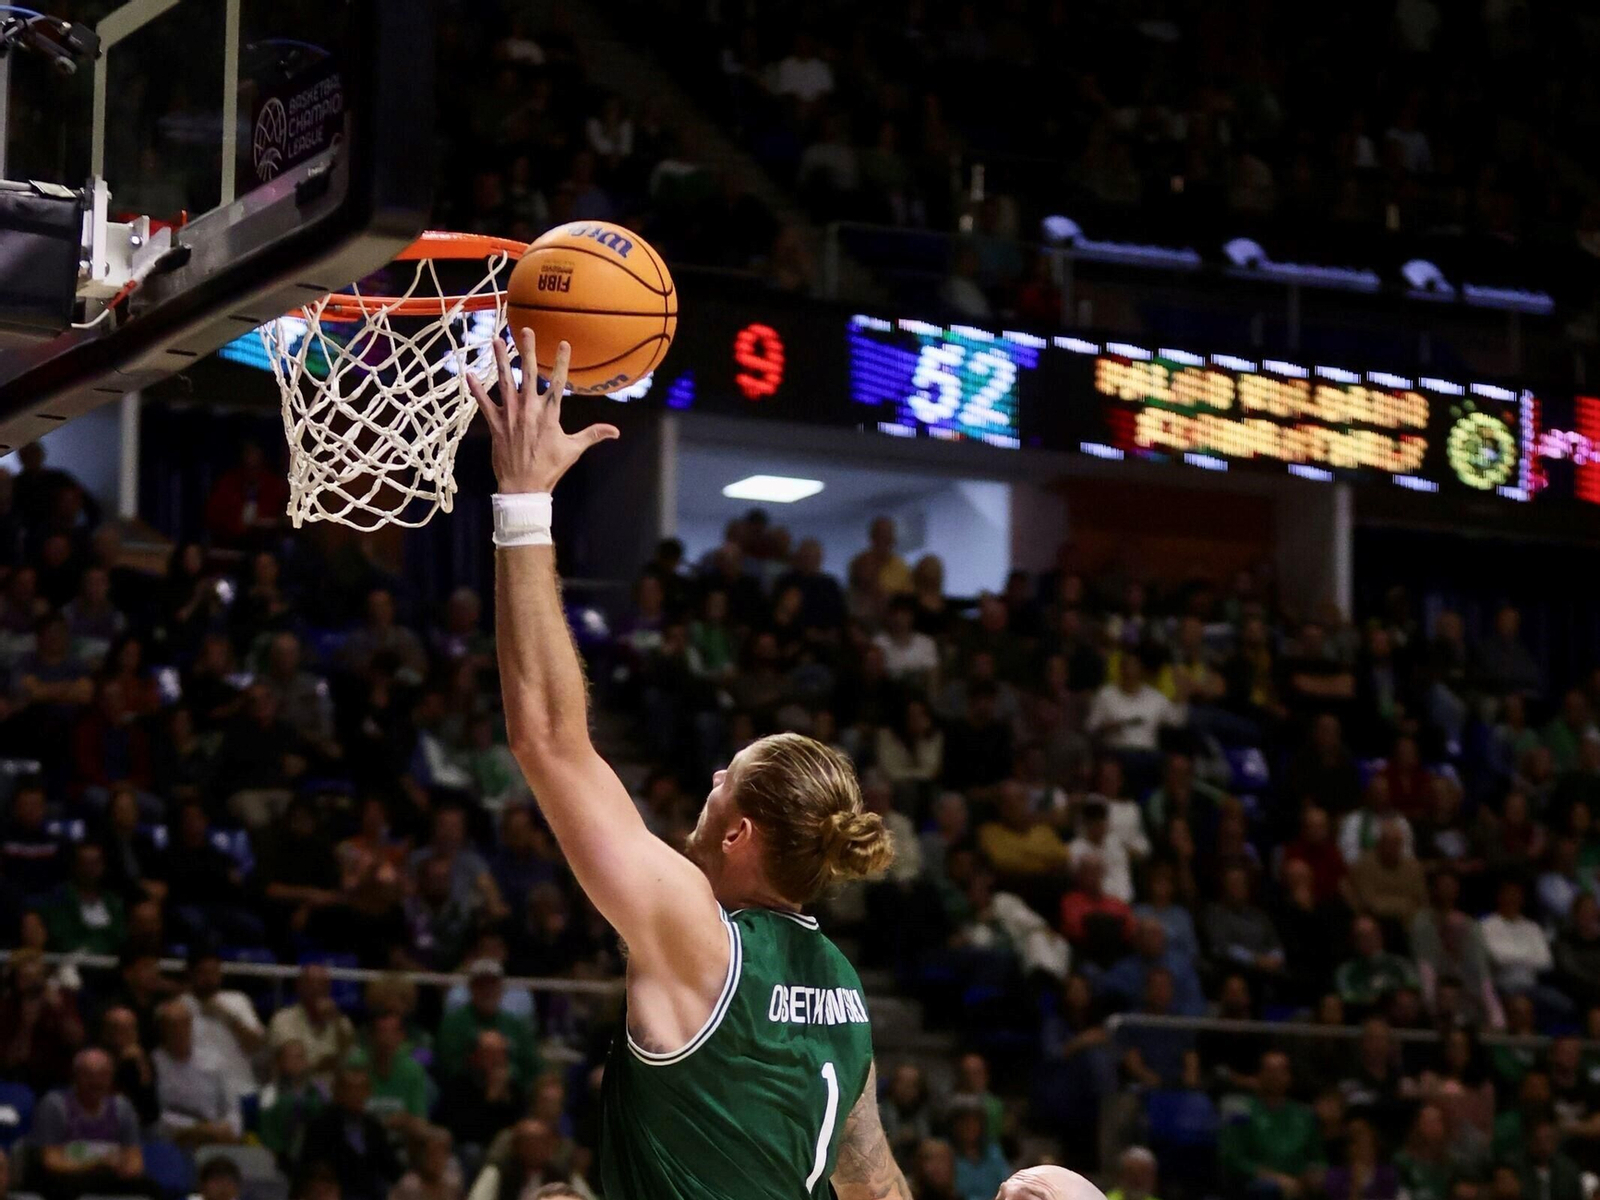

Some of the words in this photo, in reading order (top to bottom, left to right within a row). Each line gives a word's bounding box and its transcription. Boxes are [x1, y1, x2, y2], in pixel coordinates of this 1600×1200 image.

[287, 125, 323, 159] LEAGUE
[537, 272, 571, 293] FIBA
[734, 323, 785, 398] 9
[907, 343, 1018, 424] 52
[805, 1061, 840, 1194] 1
